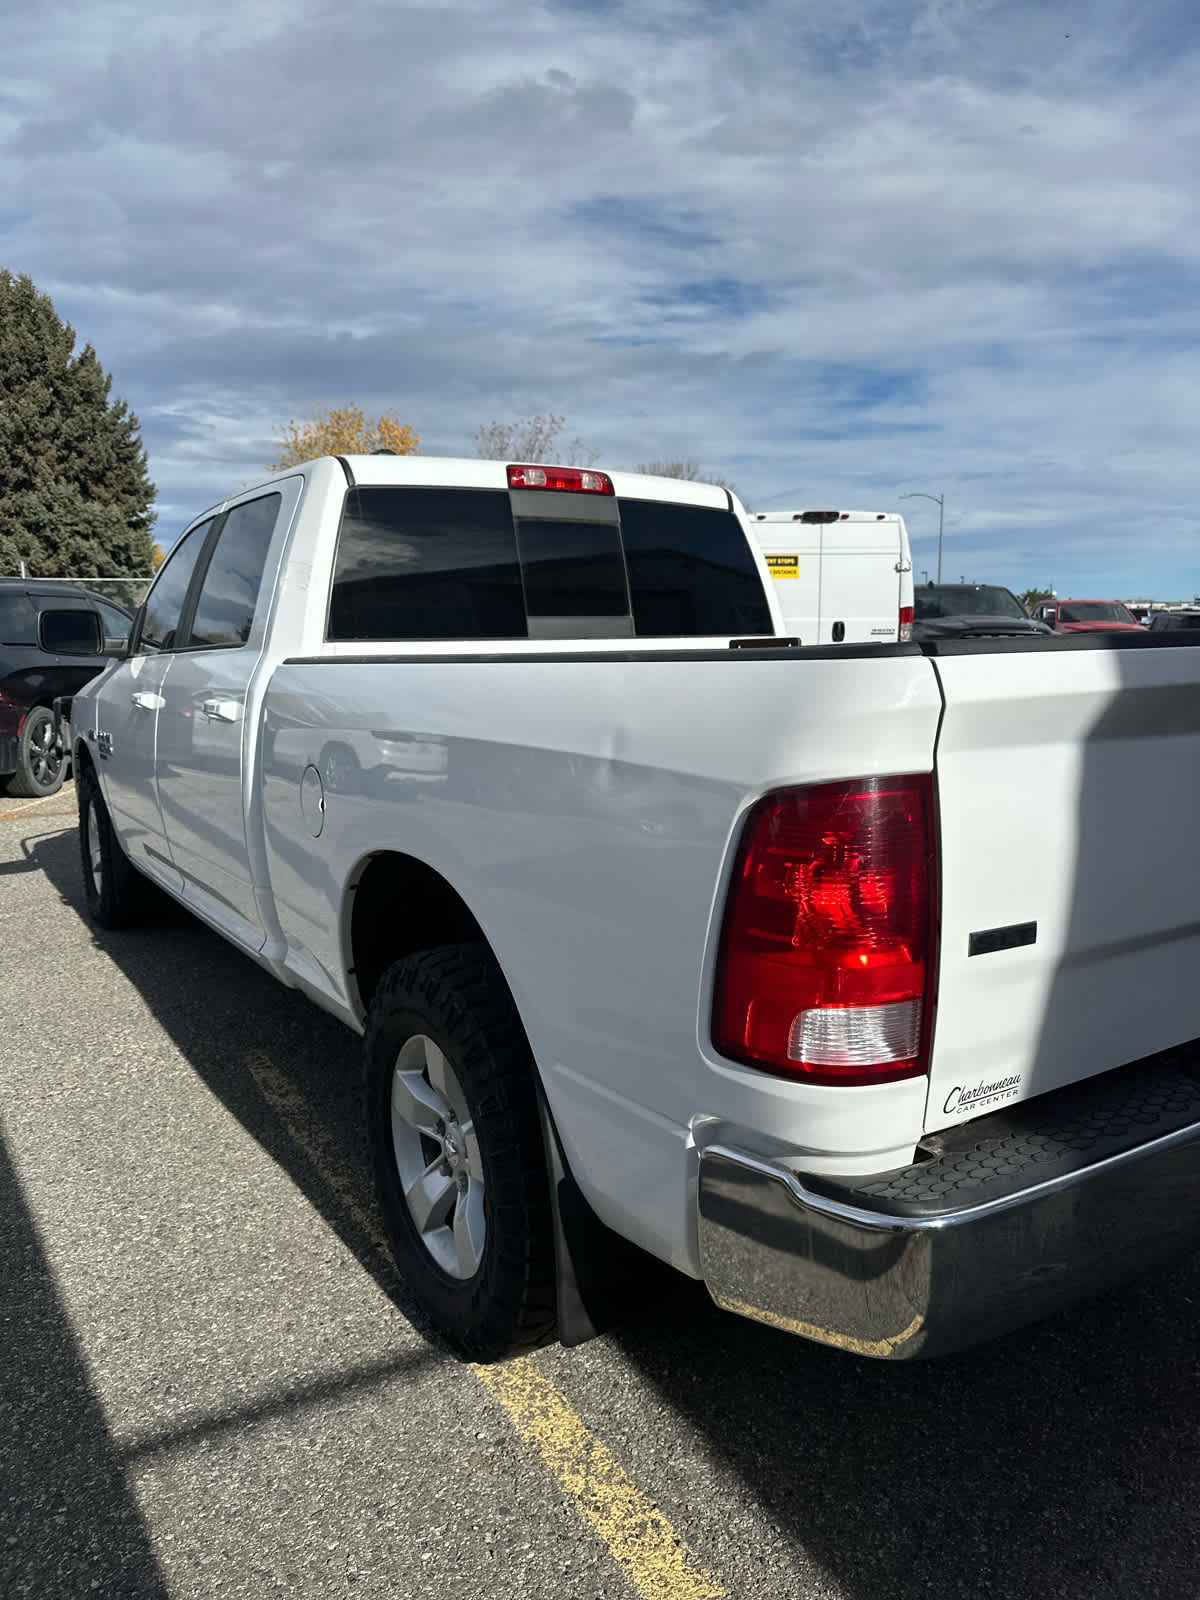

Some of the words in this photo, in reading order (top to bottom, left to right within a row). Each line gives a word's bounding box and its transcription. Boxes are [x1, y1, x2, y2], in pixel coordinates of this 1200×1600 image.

[943, 1074, 1021, 1114] Charbonneau
[956, 1103, 976, 1114] CAR
[979, 1089, 1019, 1106] CENTER
